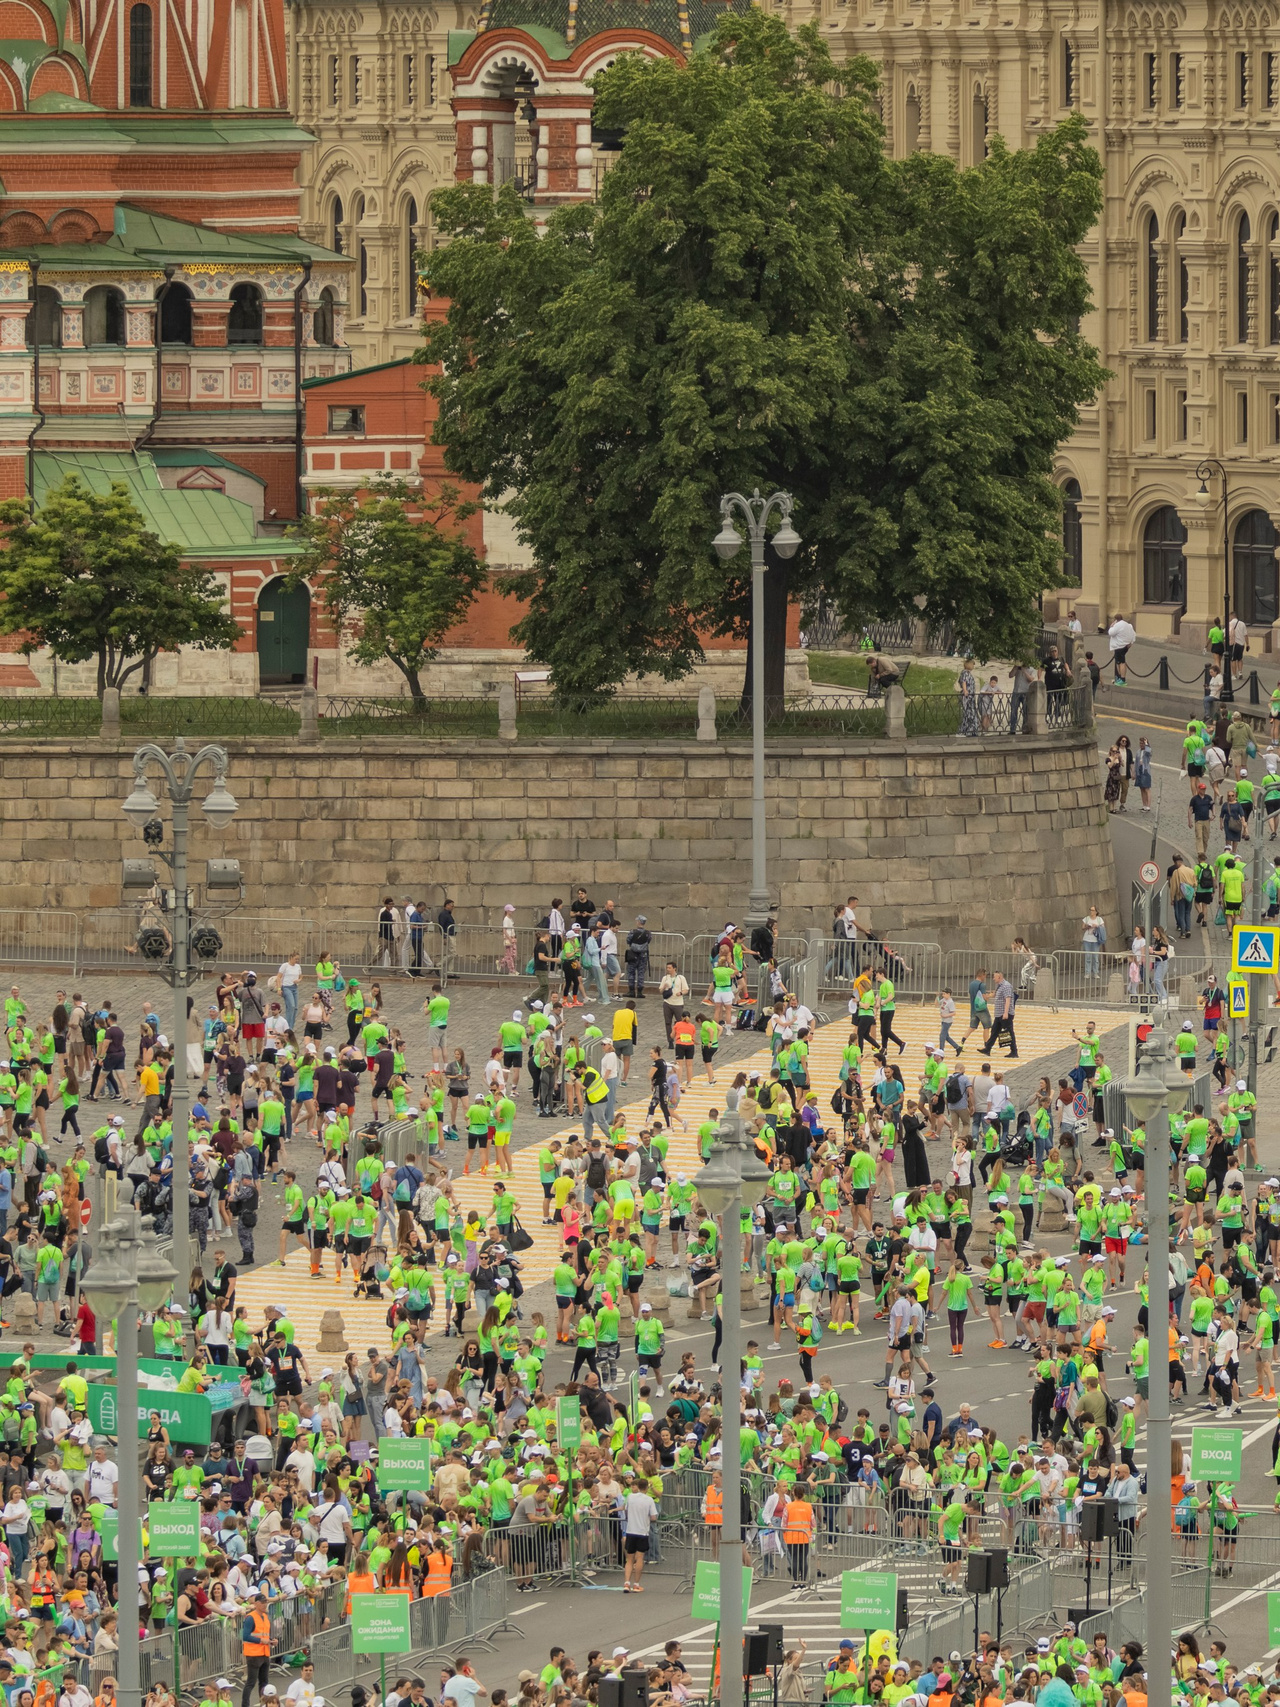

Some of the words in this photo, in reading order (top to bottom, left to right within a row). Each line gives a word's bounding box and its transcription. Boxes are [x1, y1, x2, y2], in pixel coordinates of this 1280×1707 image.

[851, 1449, 860, 1461] 3
[1201, 1450, 1232, 1461] ВХОД
[153, 1465, 166, 1474] 22
[384, 1459, 425, 1470] ВЫХОД
[153, 1524, 195, 1535] ВЫХОД
[358, 1626, 404, 1634] ОЖИДАНИЯ
